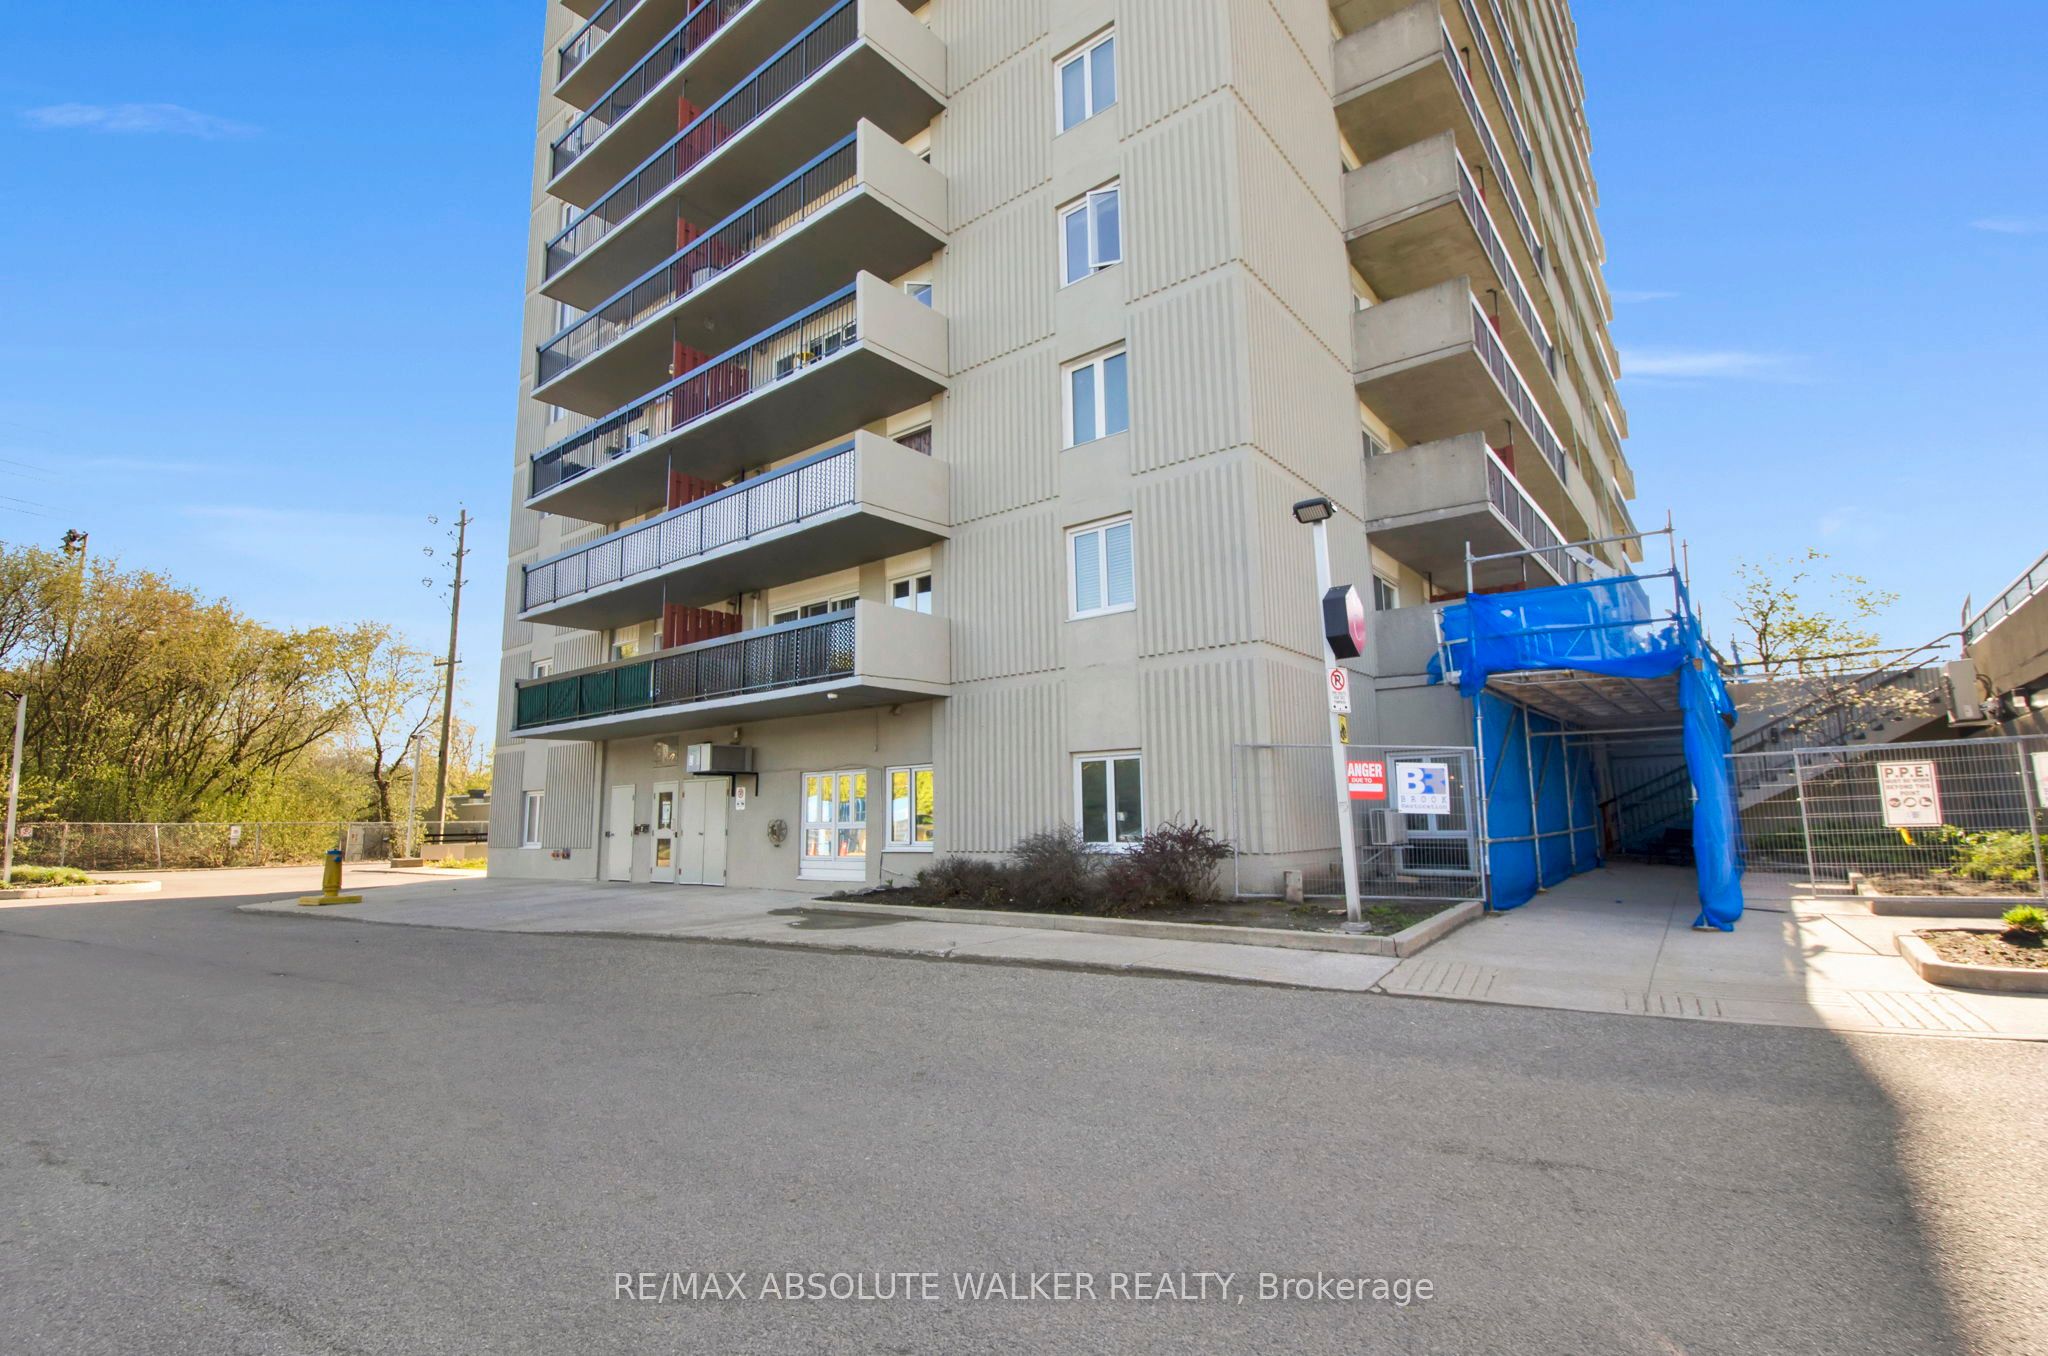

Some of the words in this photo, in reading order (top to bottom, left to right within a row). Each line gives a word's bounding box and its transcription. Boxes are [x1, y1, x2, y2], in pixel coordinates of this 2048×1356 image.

[1347, 763, 1382, 777] ANGER
[1884, 766, 1929, 778] P.P.E.
[1400, 795, 1447, 803] BROOK
